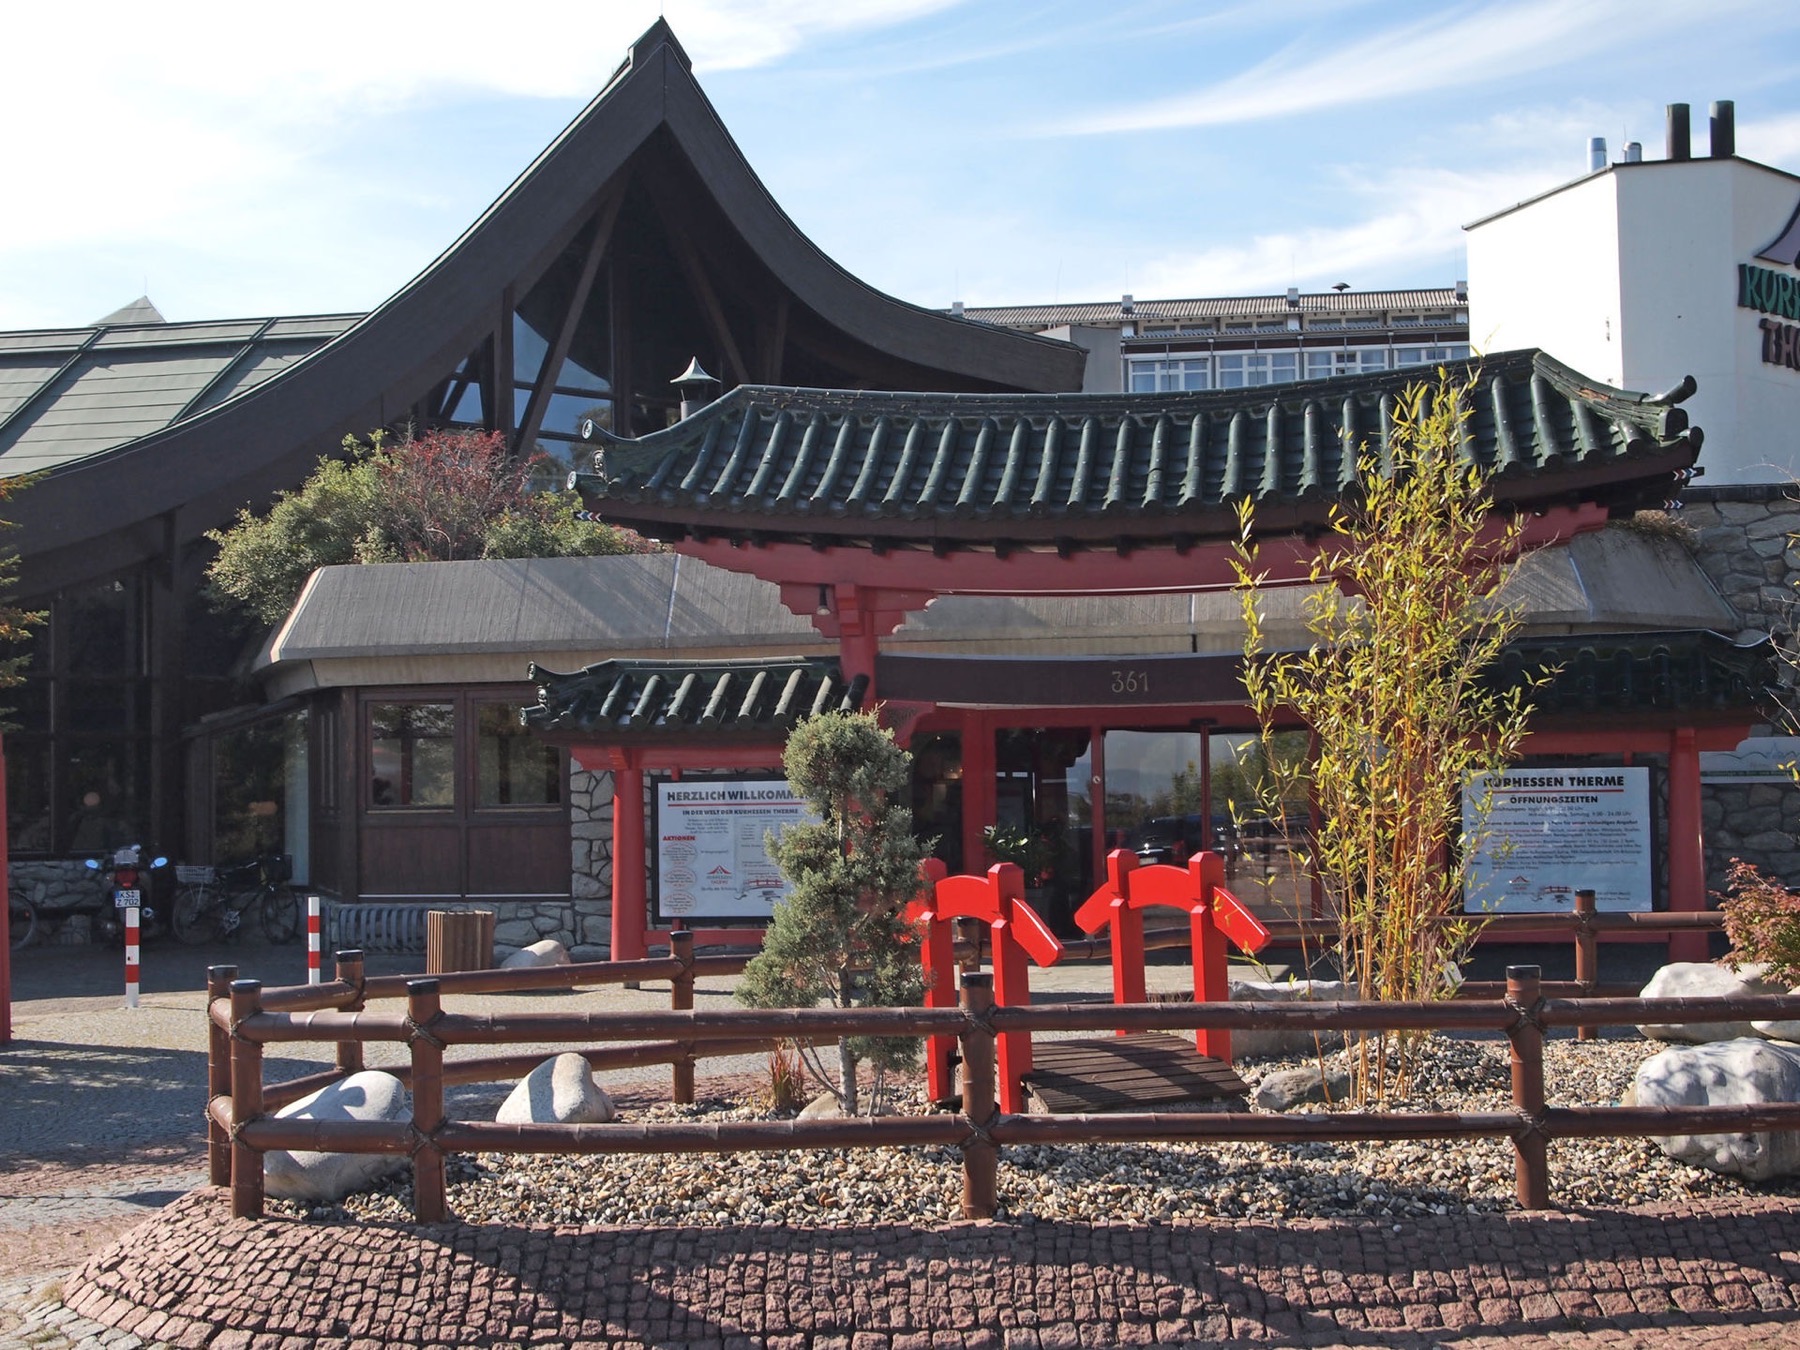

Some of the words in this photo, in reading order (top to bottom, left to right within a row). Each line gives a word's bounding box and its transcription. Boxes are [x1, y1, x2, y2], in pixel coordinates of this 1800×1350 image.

[1759, 318, 1800, 371] TH
[1112, 671, 1149, 693] 361
[1569, 776, 1624, 787] THERME
[667, 791, 726, 801] HERZLICH
[1510, 795, 1598, 805] ÖFFNUNGSZEITEN
